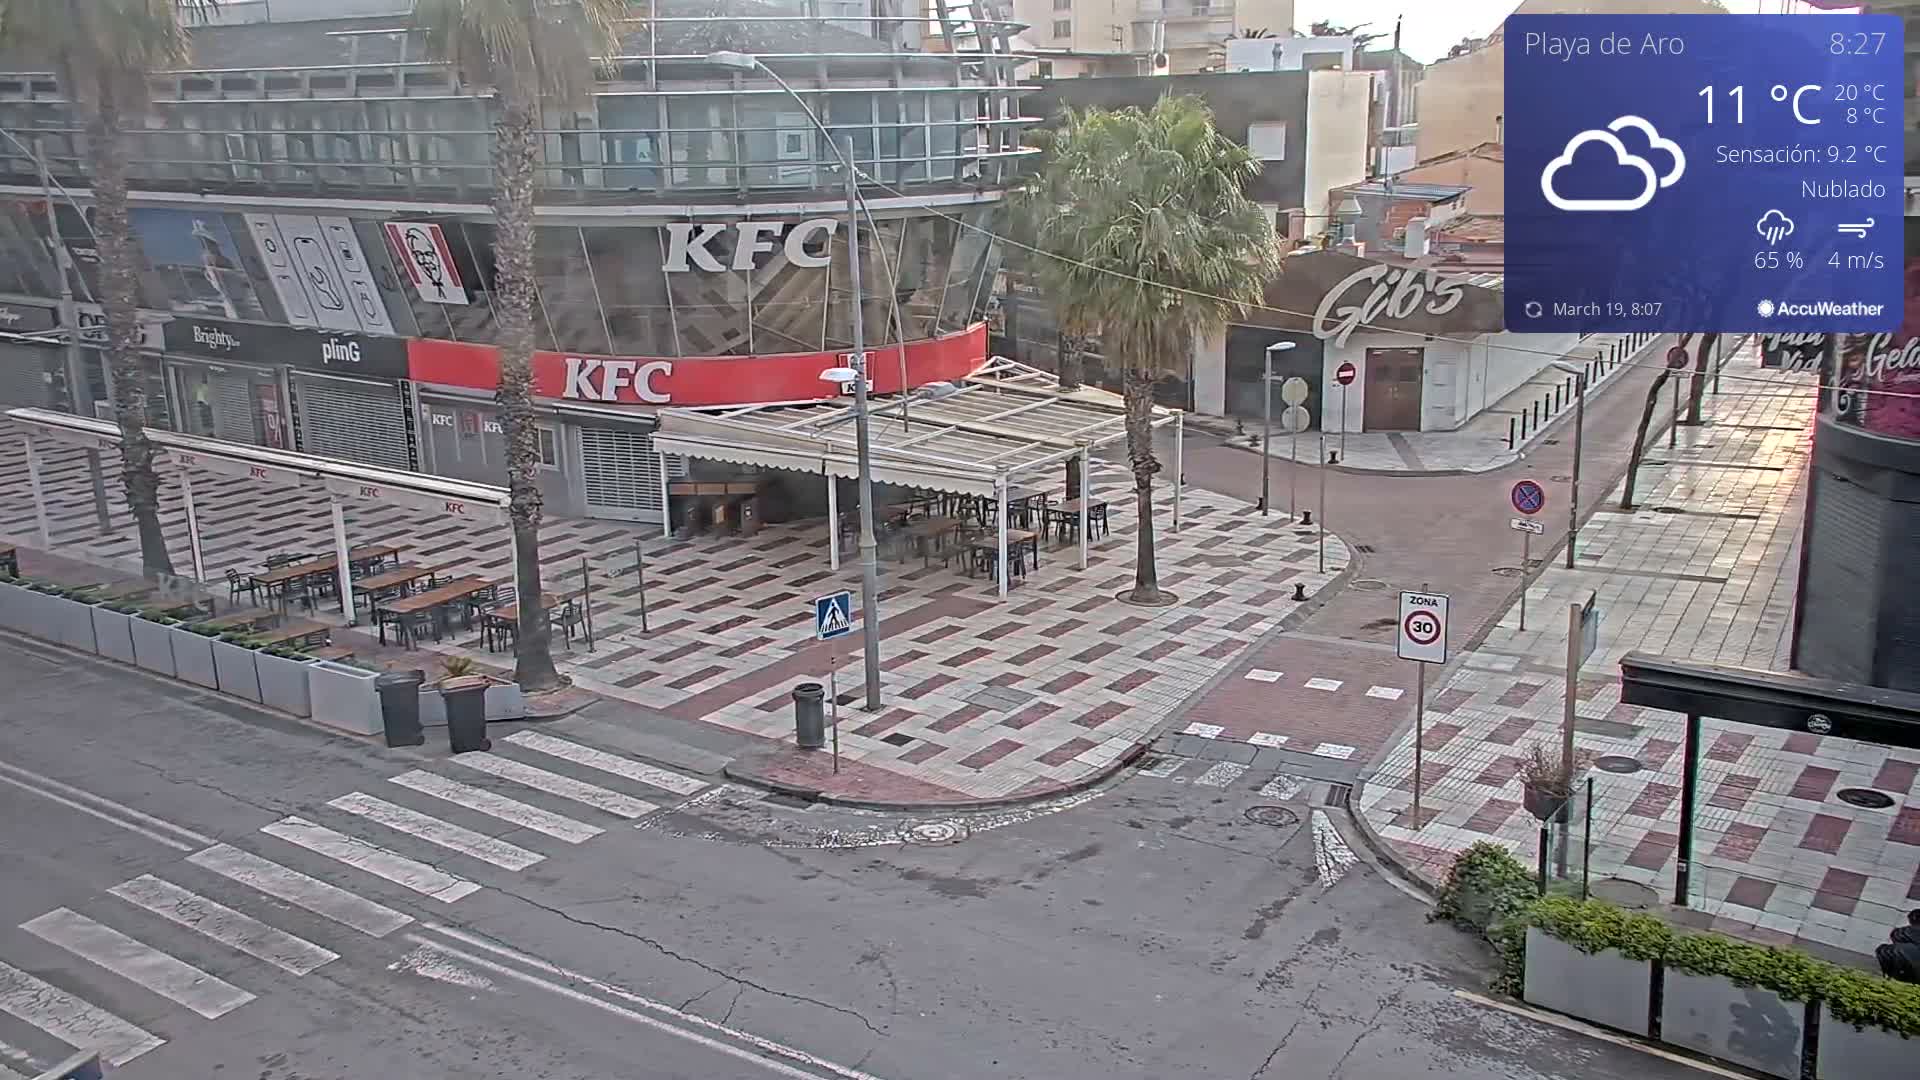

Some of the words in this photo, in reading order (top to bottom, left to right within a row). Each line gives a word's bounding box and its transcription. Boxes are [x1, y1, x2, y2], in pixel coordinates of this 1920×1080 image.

[662, 218, 838, 273] KFC
[1313, 264, 1464, 348] Gib's
[322, 338, 360, 363] plinG
[562, 358, 673, 404] KFC
[432, 414, 453, 426] KFC
[360, 486, 379, 497] KFC
[445, 502, 464, 514] KFC
[1409, 596, 1439, 607] ZONA
[1412, 621, 1433, 634] 30
